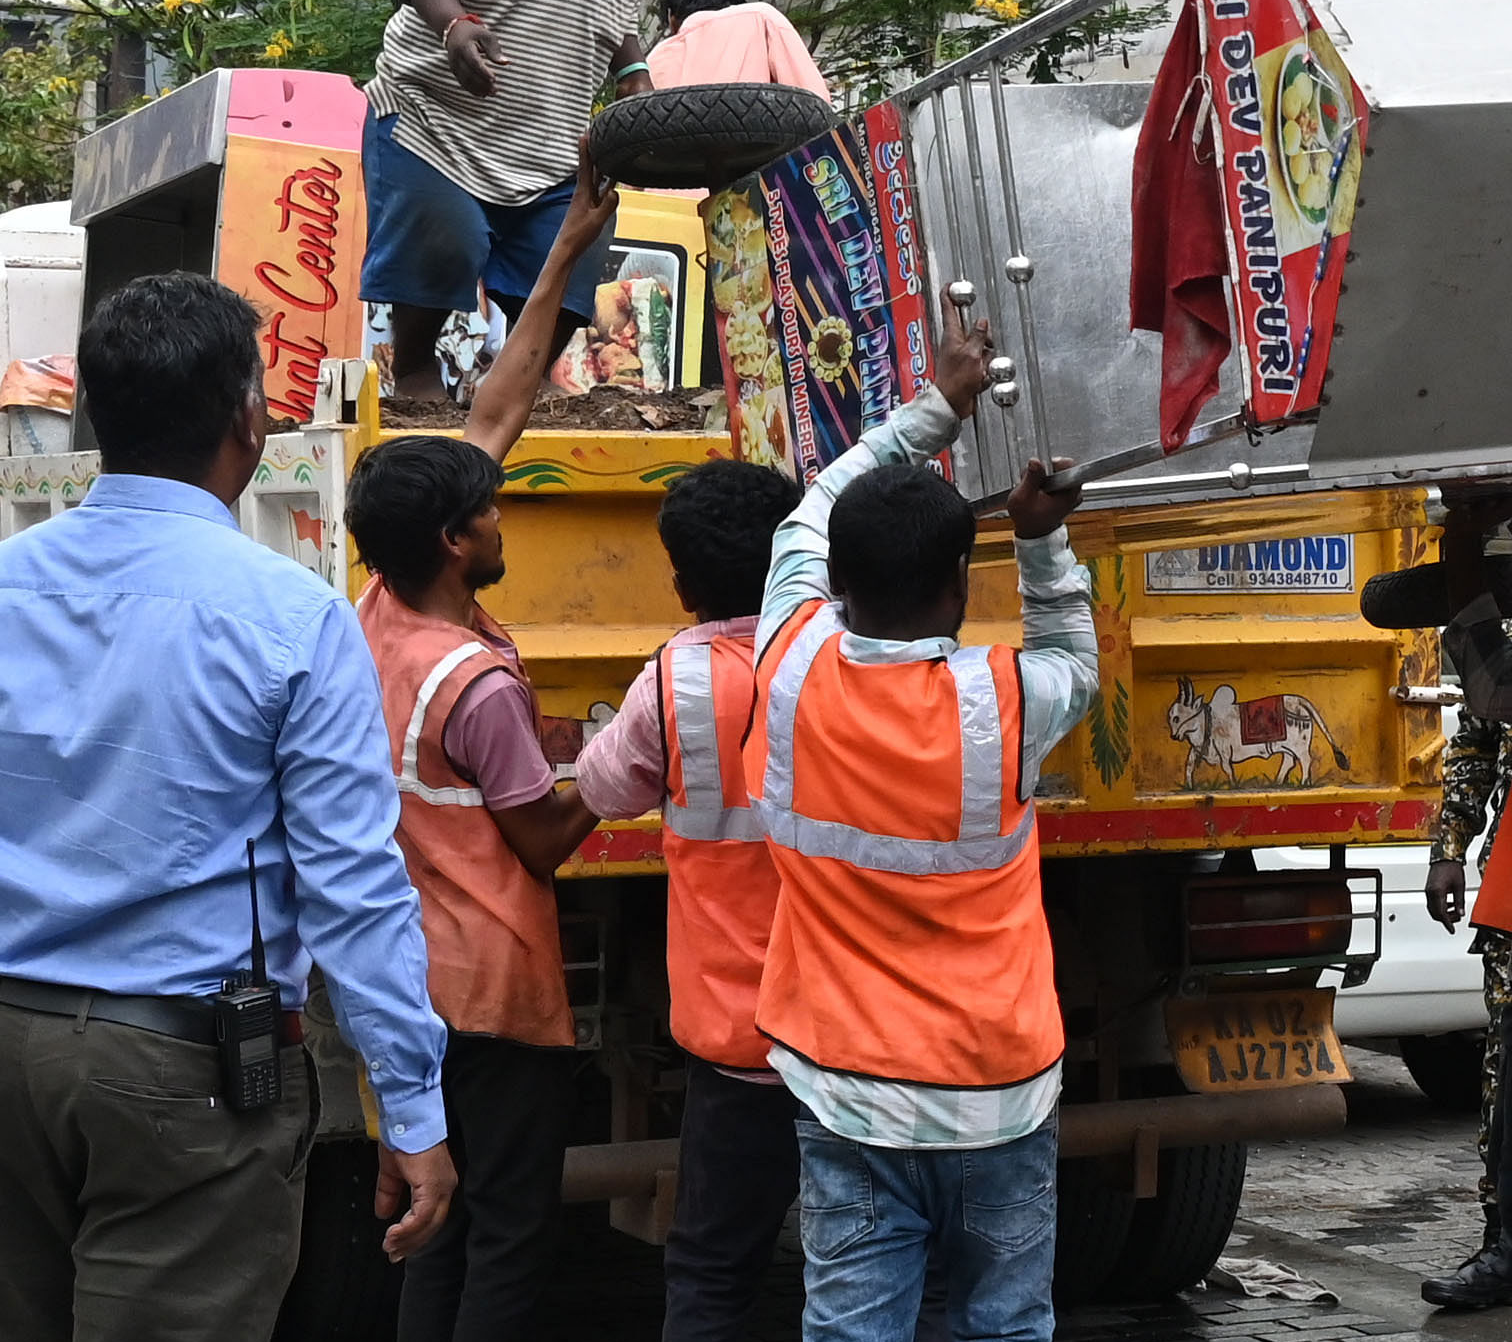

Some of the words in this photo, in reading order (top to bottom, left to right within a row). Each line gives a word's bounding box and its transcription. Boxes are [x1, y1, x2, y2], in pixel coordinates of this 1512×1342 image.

[1217, 33, 1263, 138] DEV
[254, 156, 342, 313] Center
[767, 200, 790, 257] TYPES
[802, 155, 859, 225] SRI
[836, 228, 885, 311] DEV
[774, 256, 802, 358] FLAVOURS
[1234, 148, 1294, 396] PANIPURI
[787, 357, 806, 384] IN
[791, 382, 816, 467] MINEREL
[1197, 537, 1347, 572] DIAMOND
[1206, 573, 1235, 586] Cell
[1248, 572, 1338, 587] 9343848710
[1207, 1040, 1336, 1083] AJ2734
